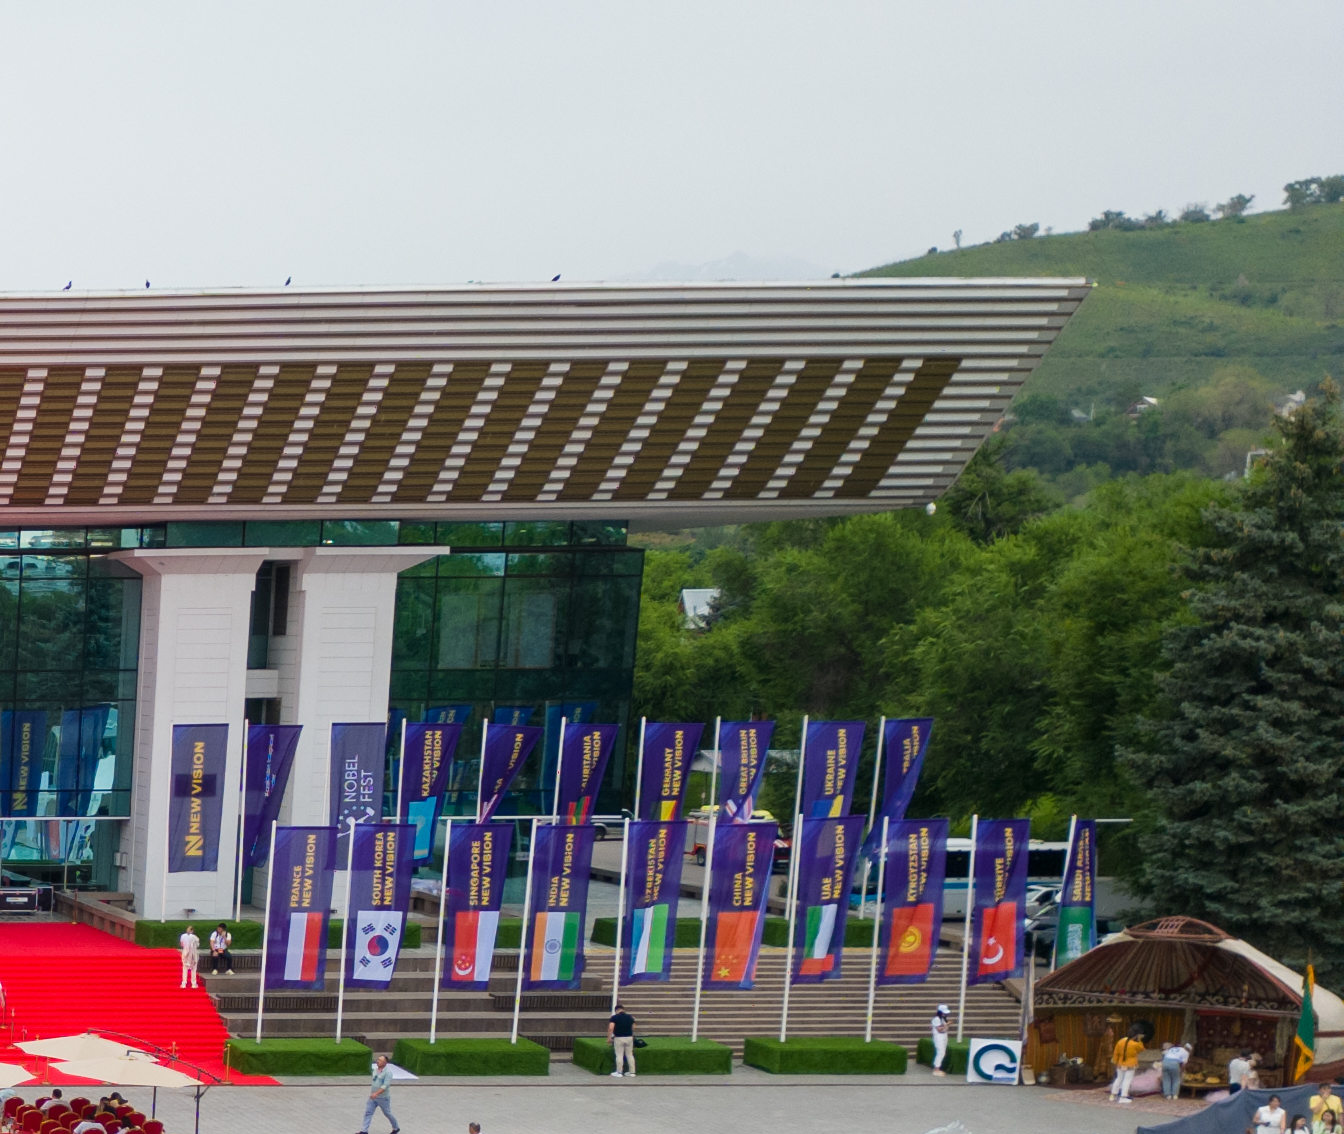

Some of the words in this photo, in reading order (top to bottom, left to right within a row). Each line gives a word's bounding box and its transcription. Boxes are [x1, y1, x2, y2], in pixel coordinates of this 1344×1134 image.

[422, 730, 433, 796] KAZAKHSTAN
[433, 730, 442, 768] VISION
[581, 735, 592, 792] AURITANIA
[674, 730, 684, 768] VISION
[740, 730, 748, 764] BRITAIN
[749, 729, 758, 766] VISION
[837, 728, 846, 766] VISION
[191, 742, 205, 795] VISION
[344, 754, 358, 802] NOBEL
[360, 770, 374, 802] FEST
[672, 770, 682, 795] NEW
[824, 750, 836, 794] UKRAINE
[190, 797, 202, 833] NEW
[306, 834, 316, 876] VISION
[374, 832, 384, 866] KOREA
[385, 832, 396, 875] VISION
[482, 832, 492, 874] VISION
[562, 834, 574, 875] VISION
[746, 832, 756, 874] VISION
[835, 825, 844, 866] VISION
[290, 866, 302, 908] FRANCE
[469, 840, 480, 906] SINGAPORE
[833, 870, 843, 898] NEW
[907, 834, 918, 902] KYRGYZSTAN
[302, 879, 313, 907] NEW
[372, 870, 382, 905] SOUTH
[384, 878, 394, 905] NEW
[481, 876, 490, 906] NEW
[548, 876, 560, 906] INDIA
[560, 878, 570, 906] NEW
[733, 872, 743, 906] CHINA
[744, 876, 754, 906] NEW
[821, 878, 832, 900] UAE
